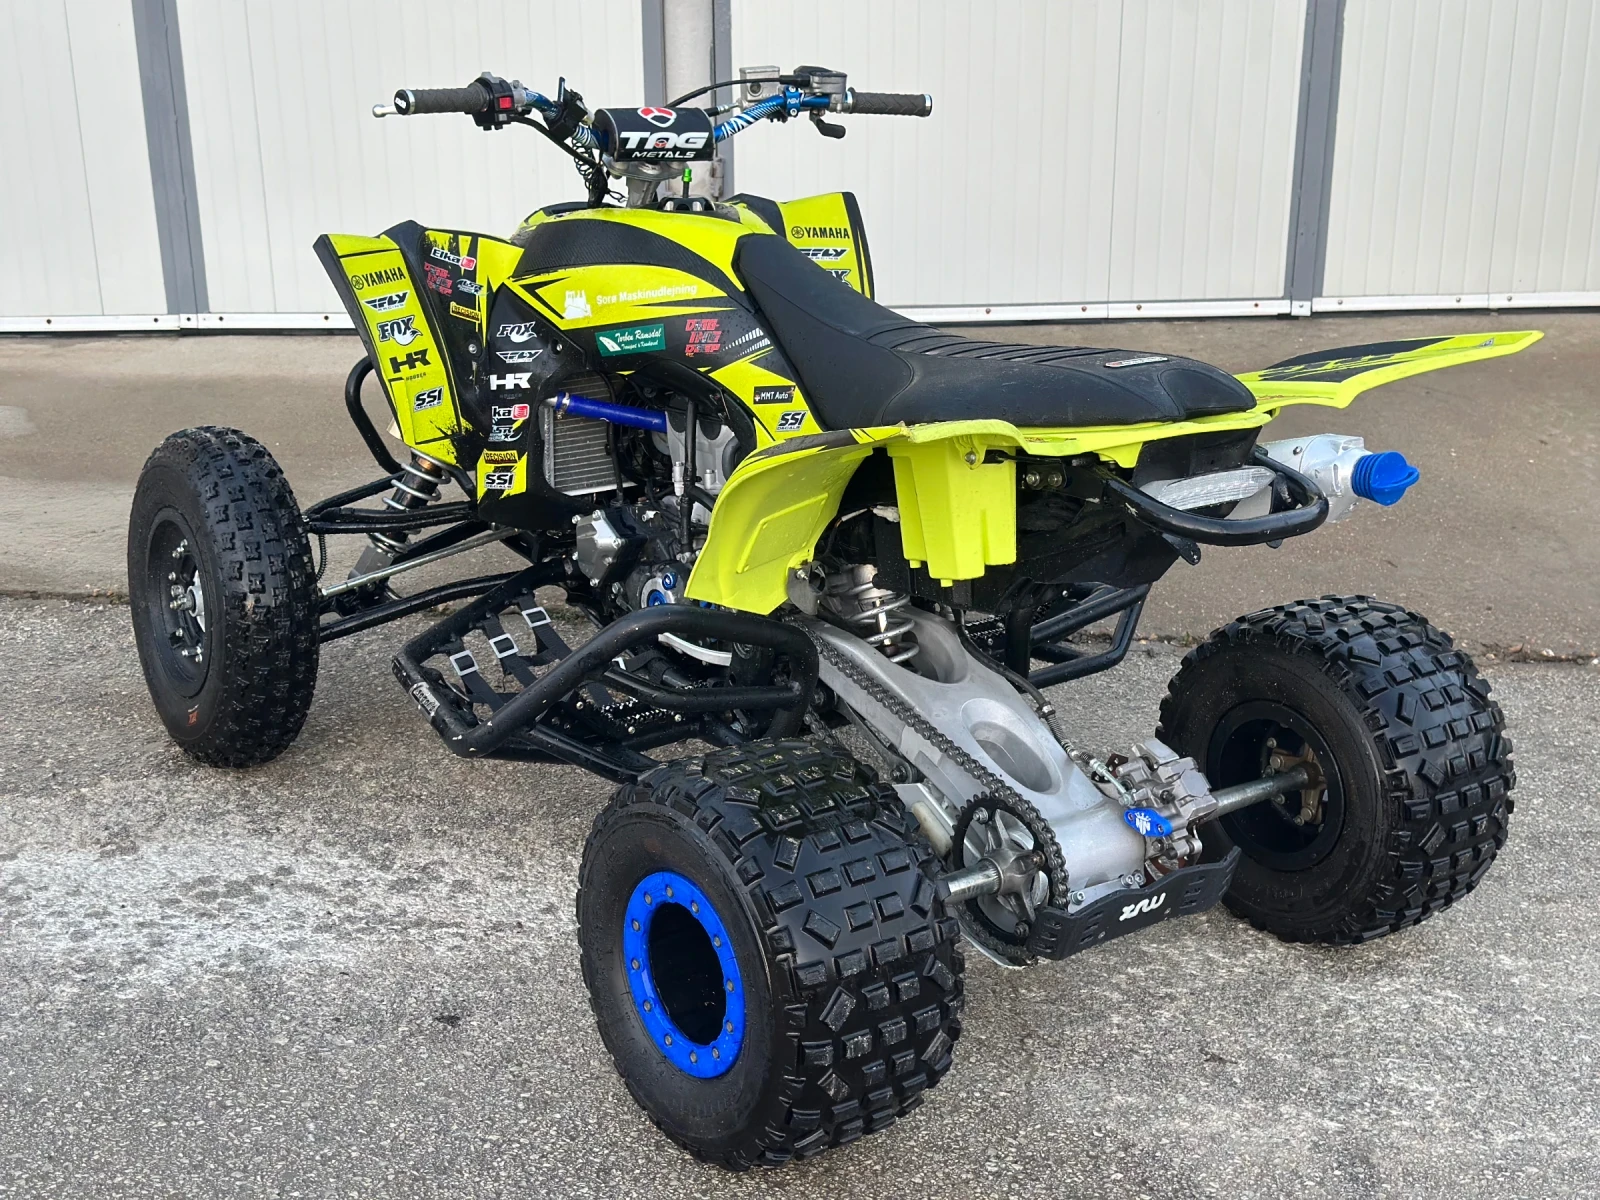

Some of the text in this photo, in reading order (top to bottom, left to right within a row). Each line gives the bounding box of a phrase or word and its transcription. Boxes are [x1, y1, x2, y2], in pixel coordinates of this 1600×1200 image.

[620, 131, 709, 149] TAG
[804, 227, 850, 239] YAMAHA
[433, 249, 460, 263] Elka
[362, 266, 406, 287] YAMAHA
[365, 292, 408, 308] FLY
[596, 284, 697, 305] Sorø Maskinudlejning
[451, 305, 479, 318] RECISION
[378, 315, 415, 341] FOX
[497, 321, 536, 337] FOX
[389, 348, 431, 374] HR
[496, 350, 541, 360] FLY
[490, 372, 533, 390] HR
[415, 388, 442, 406] SSI
[760, 391, 788, 400] MMT Auto
[779, 411, 807, 426] SSI
[484, 452, 516, 461] RECISION
[486, 474, 513, 485] SSI
